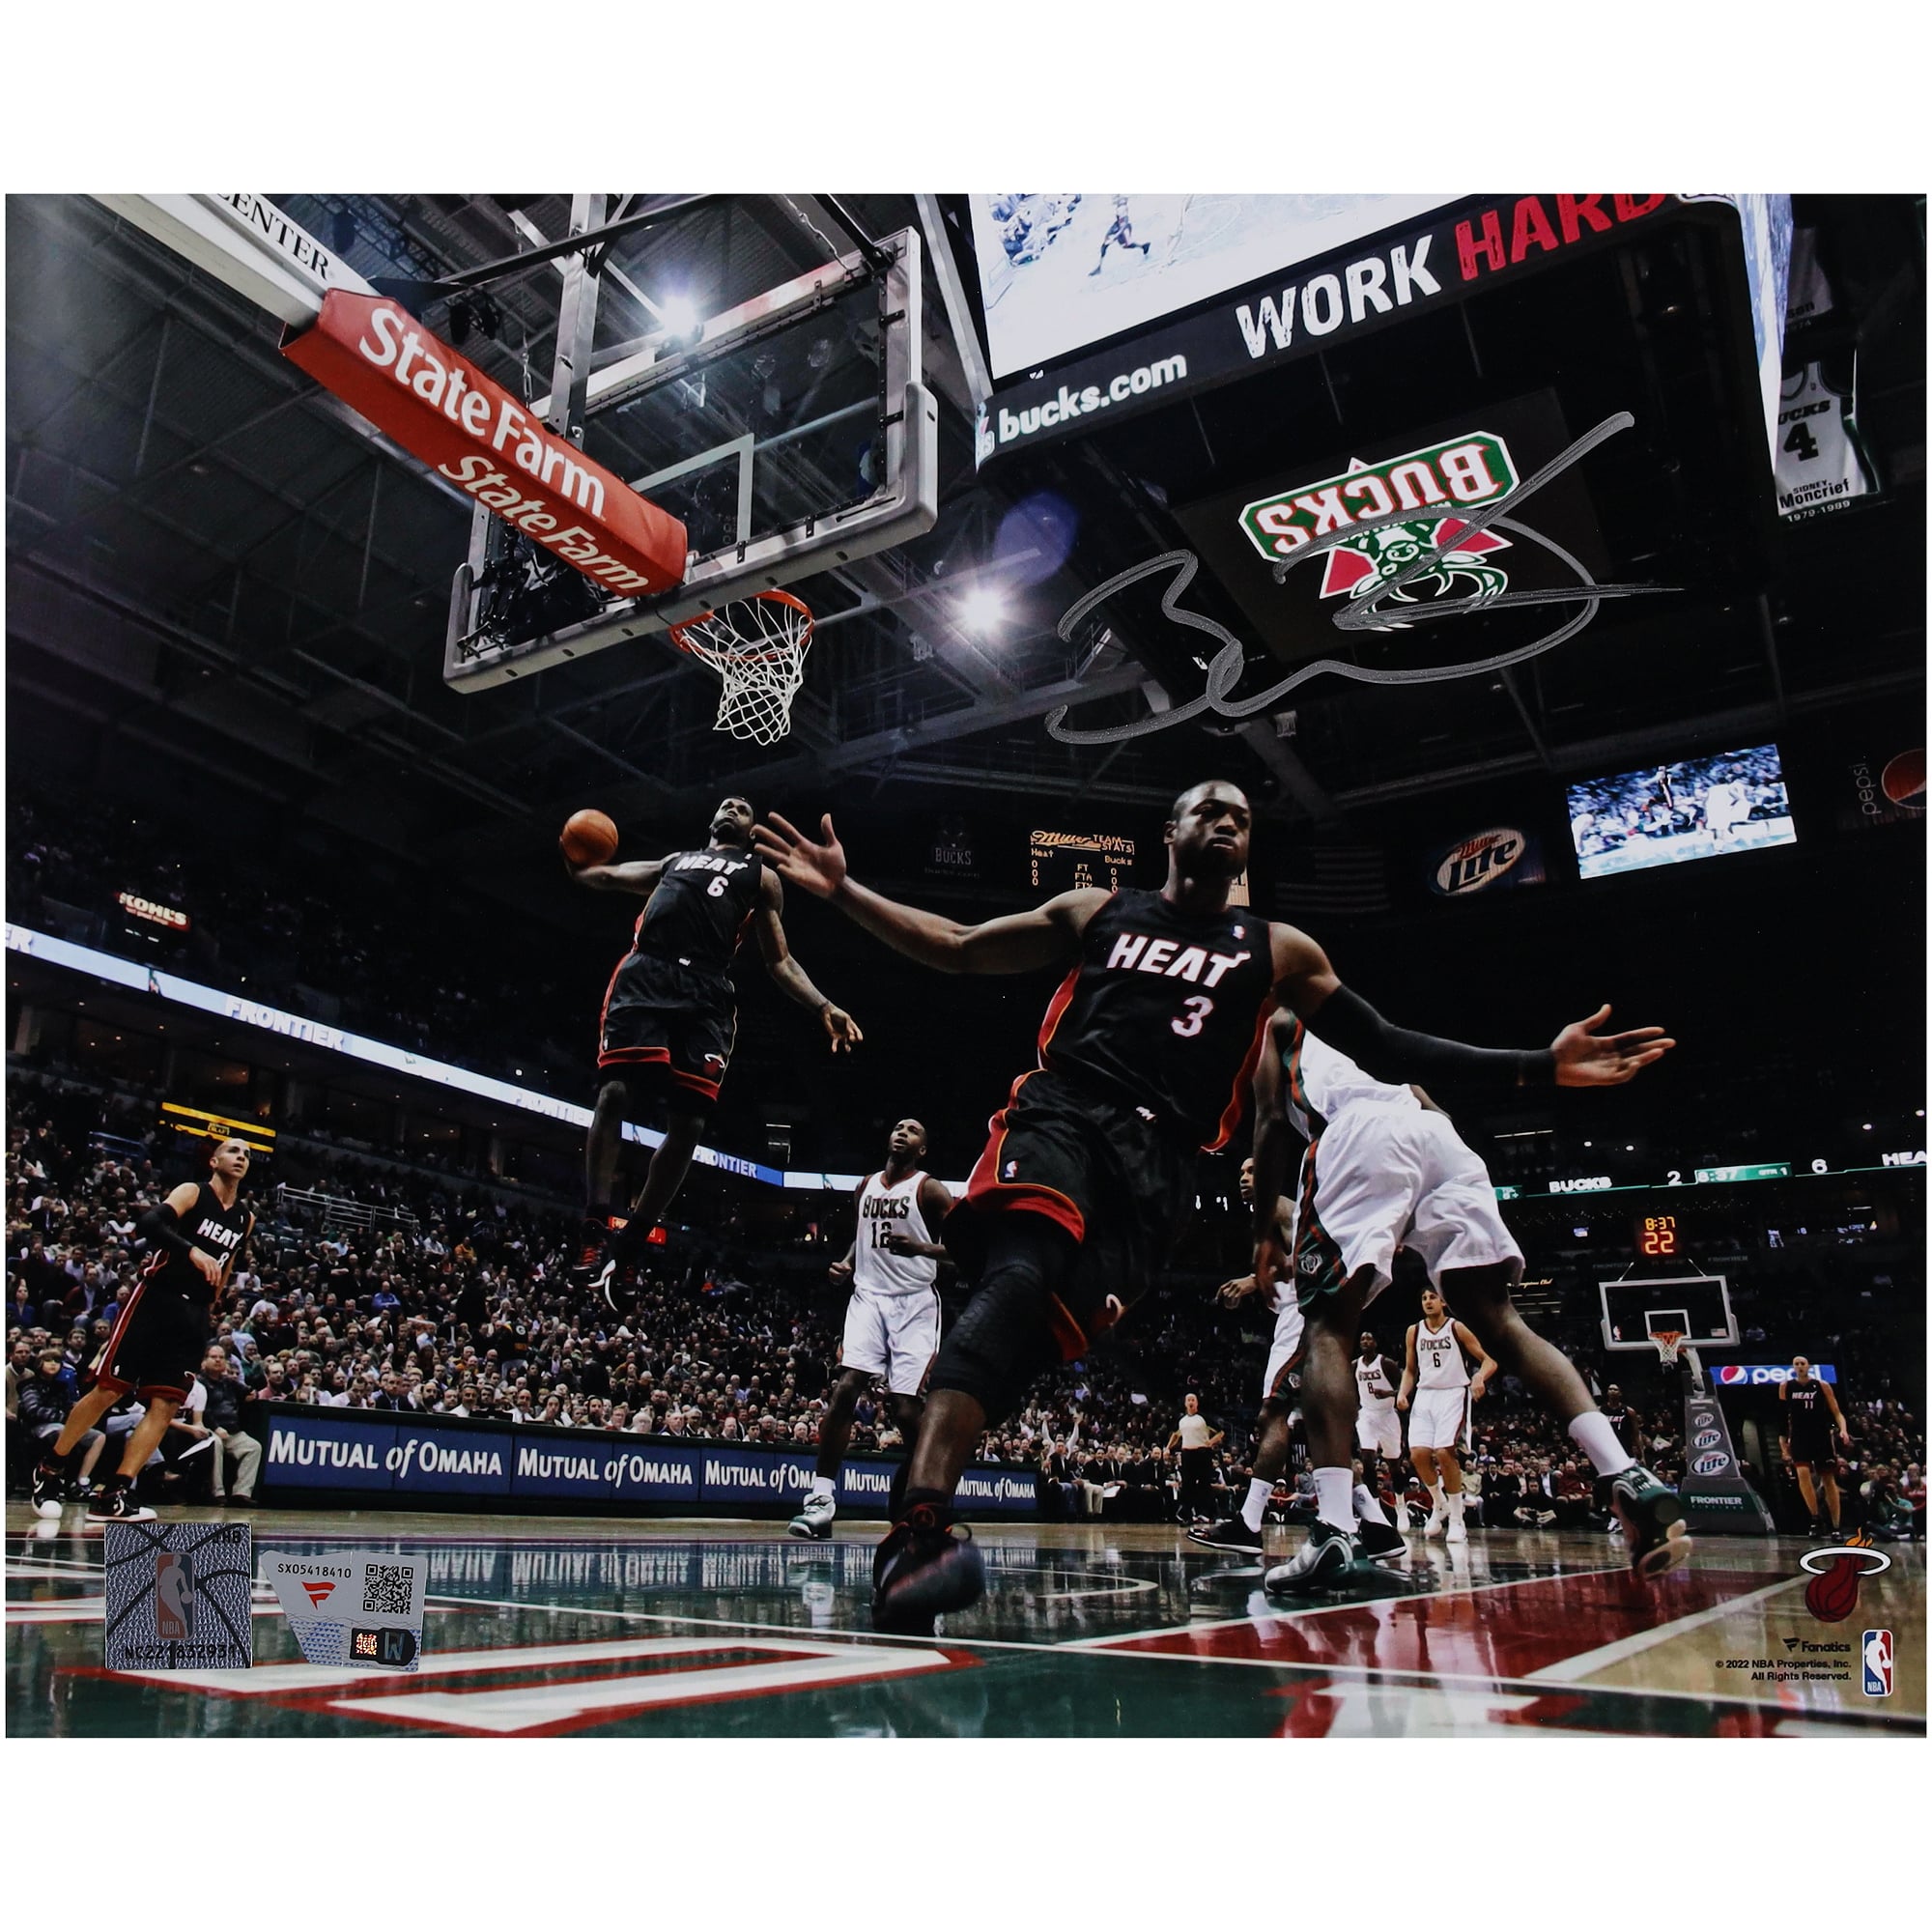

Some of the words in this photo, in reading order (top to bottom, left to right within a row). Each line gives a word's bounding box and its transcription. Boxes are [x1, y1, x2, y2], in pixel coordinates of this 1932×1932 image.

[217, 193, 327, 280] ENTER
[1236, 235, 1441, 359] WORK
[999, 354, 1187, 443] bucks.com
[1778, 400, 1831, 425] UCKS
[1783, 422, 1818, 461] 4
[1255, 442, 1503, 554] BUCKS
[1779, 479, 1849, 508] Moncrief
[1793, 479, 1828, 494] SIDNEY
[1787, 500, 1851, 523] 1979-1989
[1848, 762, 1883, 815] pepsi
[1093, 834, 1122, 844] TEAM
[1102, 843, 1132, 854] STATS
[935, 847, 972, 866] BUCKS
[1031, 848, 1055, 858] Heat
[1031, 860, 1038, 868] 0
[1104, 855, 1132, 866] Bucks
[675, 855, 749, 875] HEAT
[1032, 868, 1038, 877] 0
[1074, 872, 1093, 881] FTA
[1449, 839, 1517, 893] Lite
[707, 875, 729, 897] 6
[1032, 877, 1038, 886] 0
[1111, 876, 1118, 885] 0
[127, 895, 187, 925] KOHL'S
[1106, 932, 1251, 988] HEAT
[224, 995, 345, 1052] FRONTIER
[1171, 995, 1214, 1037] 3
[693, 1147, 757, 1179] FRONTIER
[1666, 1171, 1683, 1186] 2
[1697, 1170, 1738, 1183] 8:37
[1811, 1159, 1829, 1175] 6
[863, 1194, 910, 1219] BUCKS
[196, 1218, 244, 1250] HEAT
[871, 1221, 893, 1249] 12
[1645, 1216, 1676, 1231] 8:37
[1644, 1231, 1675, 1255] 22
[1420, 1336, 1451, 1351] BUCKS
[1433, 1352, 1441, 1368] 6
[1792, 1390, 1817, 1400] HEAT
[1804, 1400, 1813, 1409] 11
[268, 1430, 379, 1469] MUTUAL
[385, 1439, 418, 1479] of
[418, 1441, 502, 1475] OMAHA
[1700, 1456, 1726, 1474] Lite
[518, 1448, 600, 1481] MUTUAL
[604, 1454, 629, 1489] of
[629, 1455, 693, 1485] OMAHA
[705, 1460, 766, 1488] MUTUAL
[770, 1463, 786, 1493] of
[787, 1464, 817, 1489] OMA
[955, 1475, 993, 1497] MUTUAL
[994, 1477, 1006, 1502] of
[1005, 1478, 1036, 1498] OMAHA
[1690, 1495, 1743, 1505] FRONTIER
[277, 1563, 352, 1578] SX05418410
[162, 1621, 181, 1635] NBA
